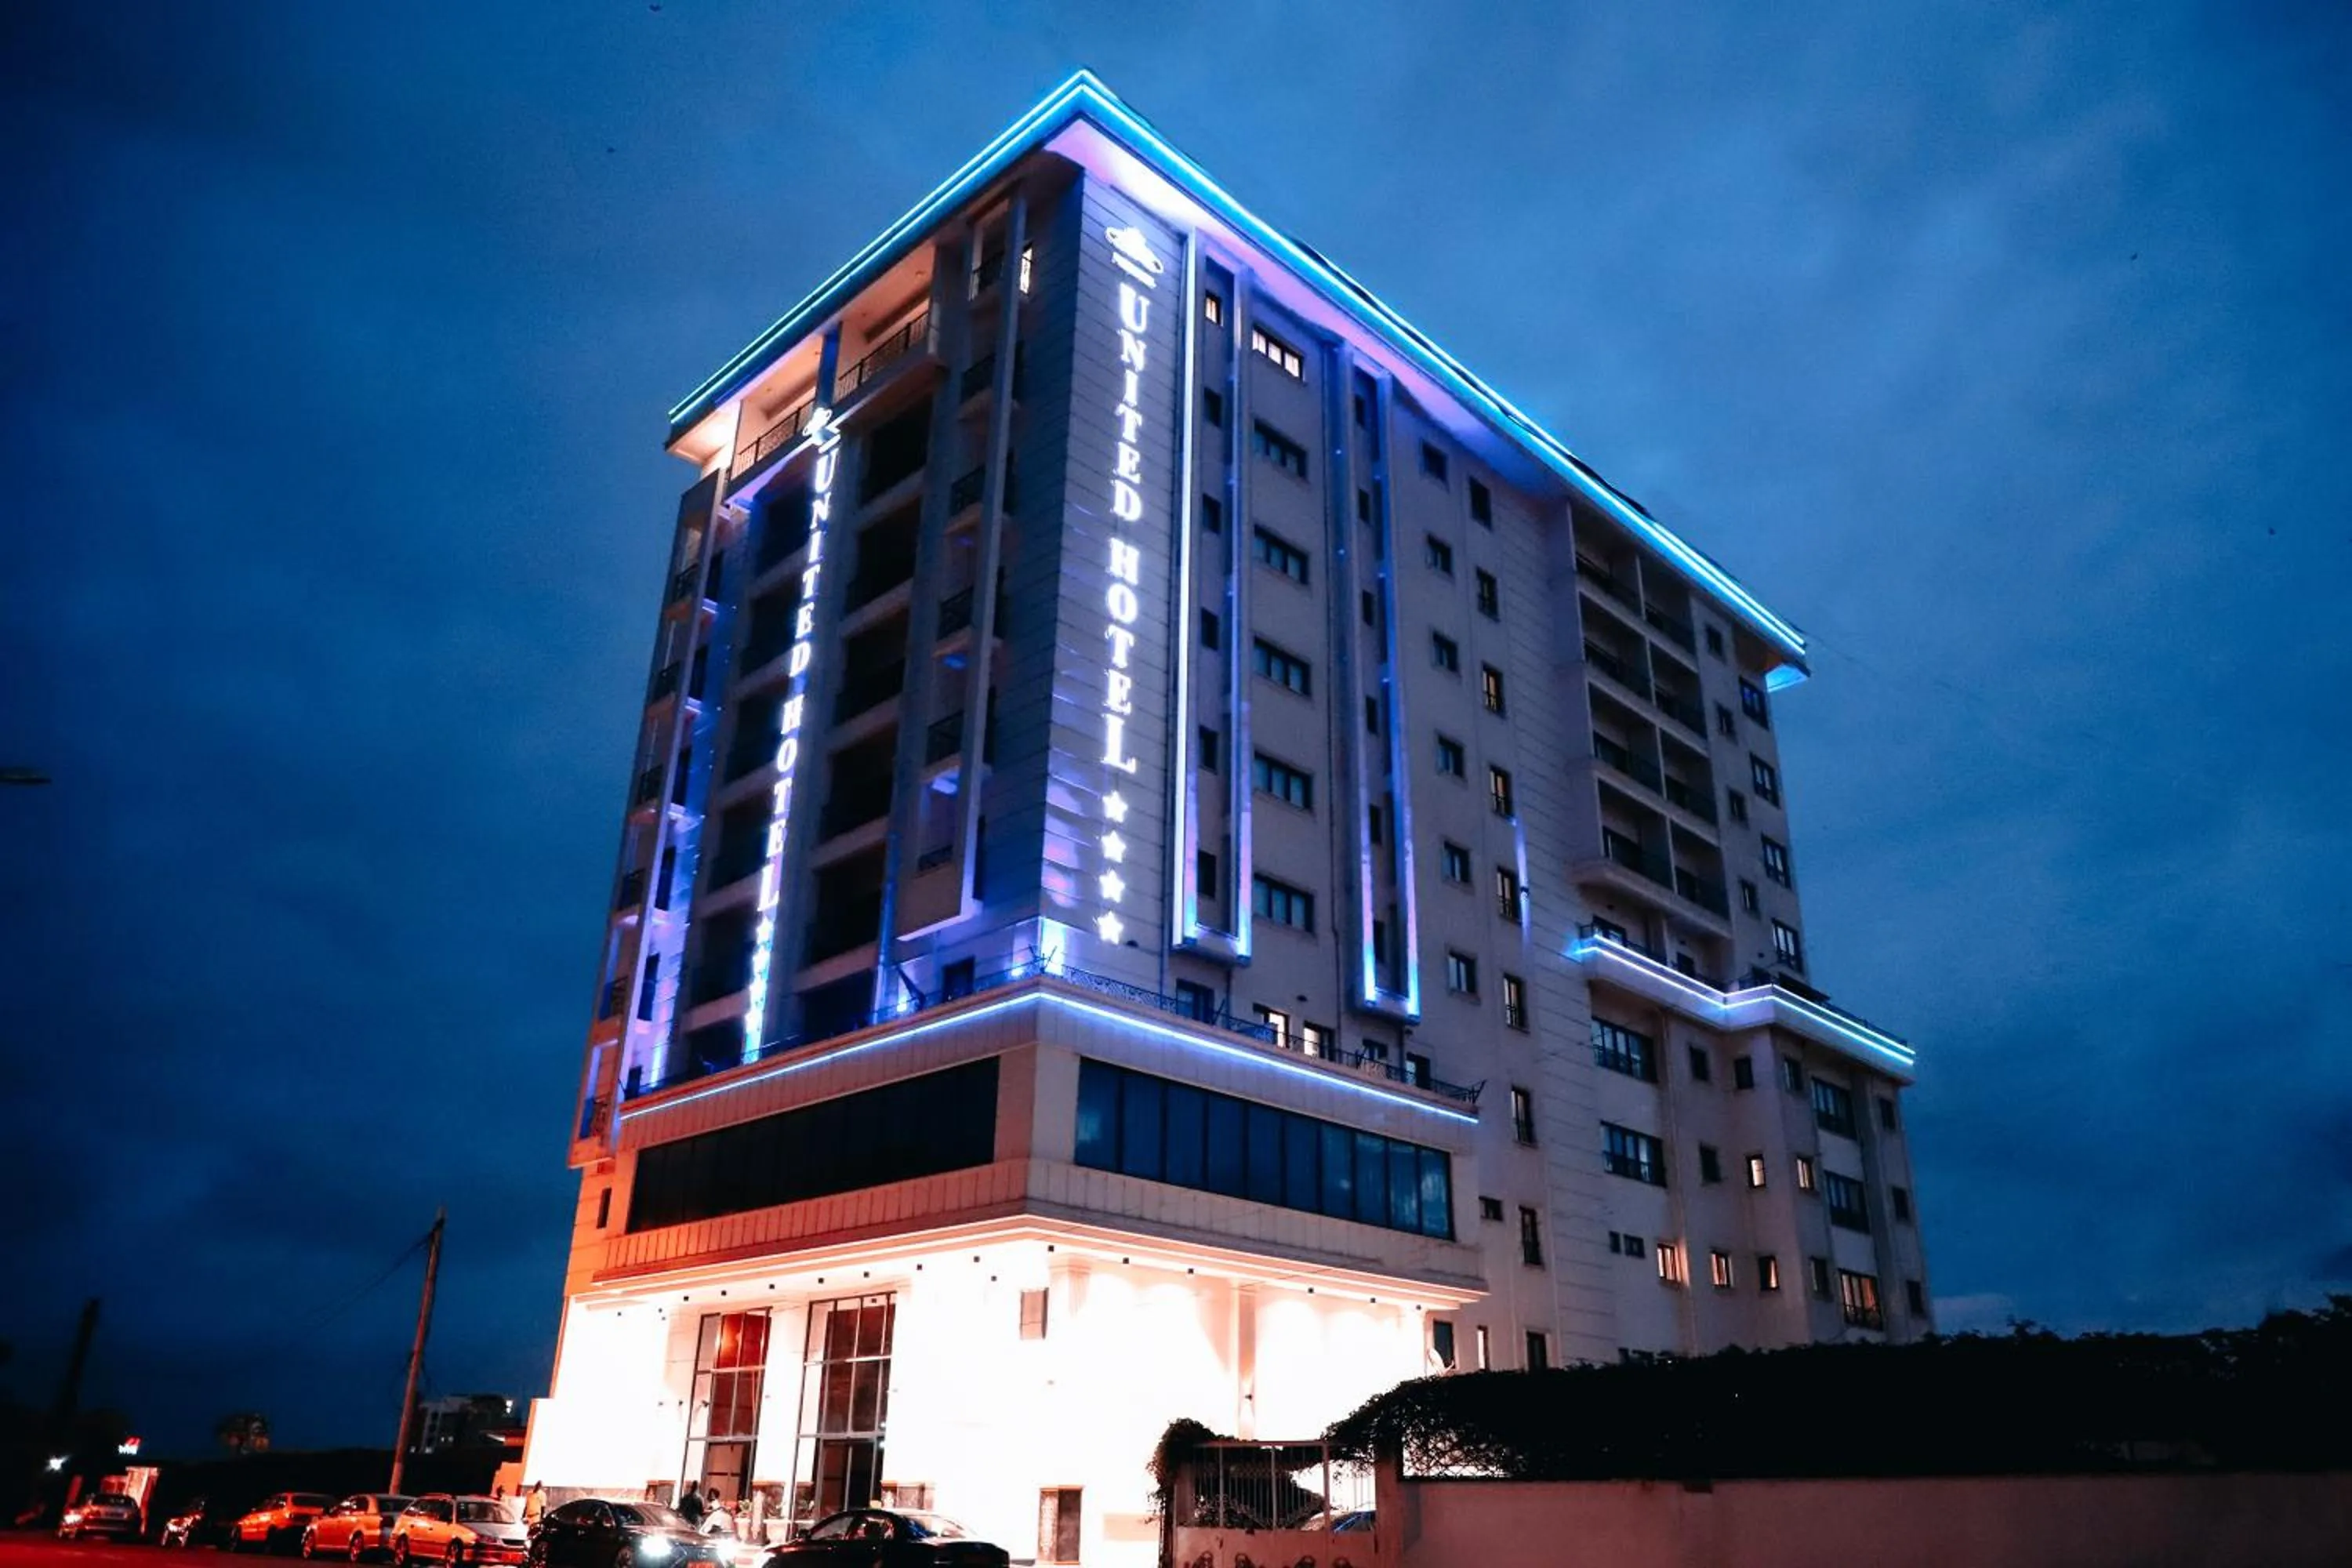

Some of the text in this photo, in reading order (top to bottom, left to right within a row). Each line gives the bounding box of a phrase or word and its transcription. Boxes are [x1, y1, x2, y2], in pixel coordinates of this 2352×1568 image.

[757, 448, 839, 913] UNITED HOTEL
[1103, 282, 1149, 775] UNITED HOTEL
